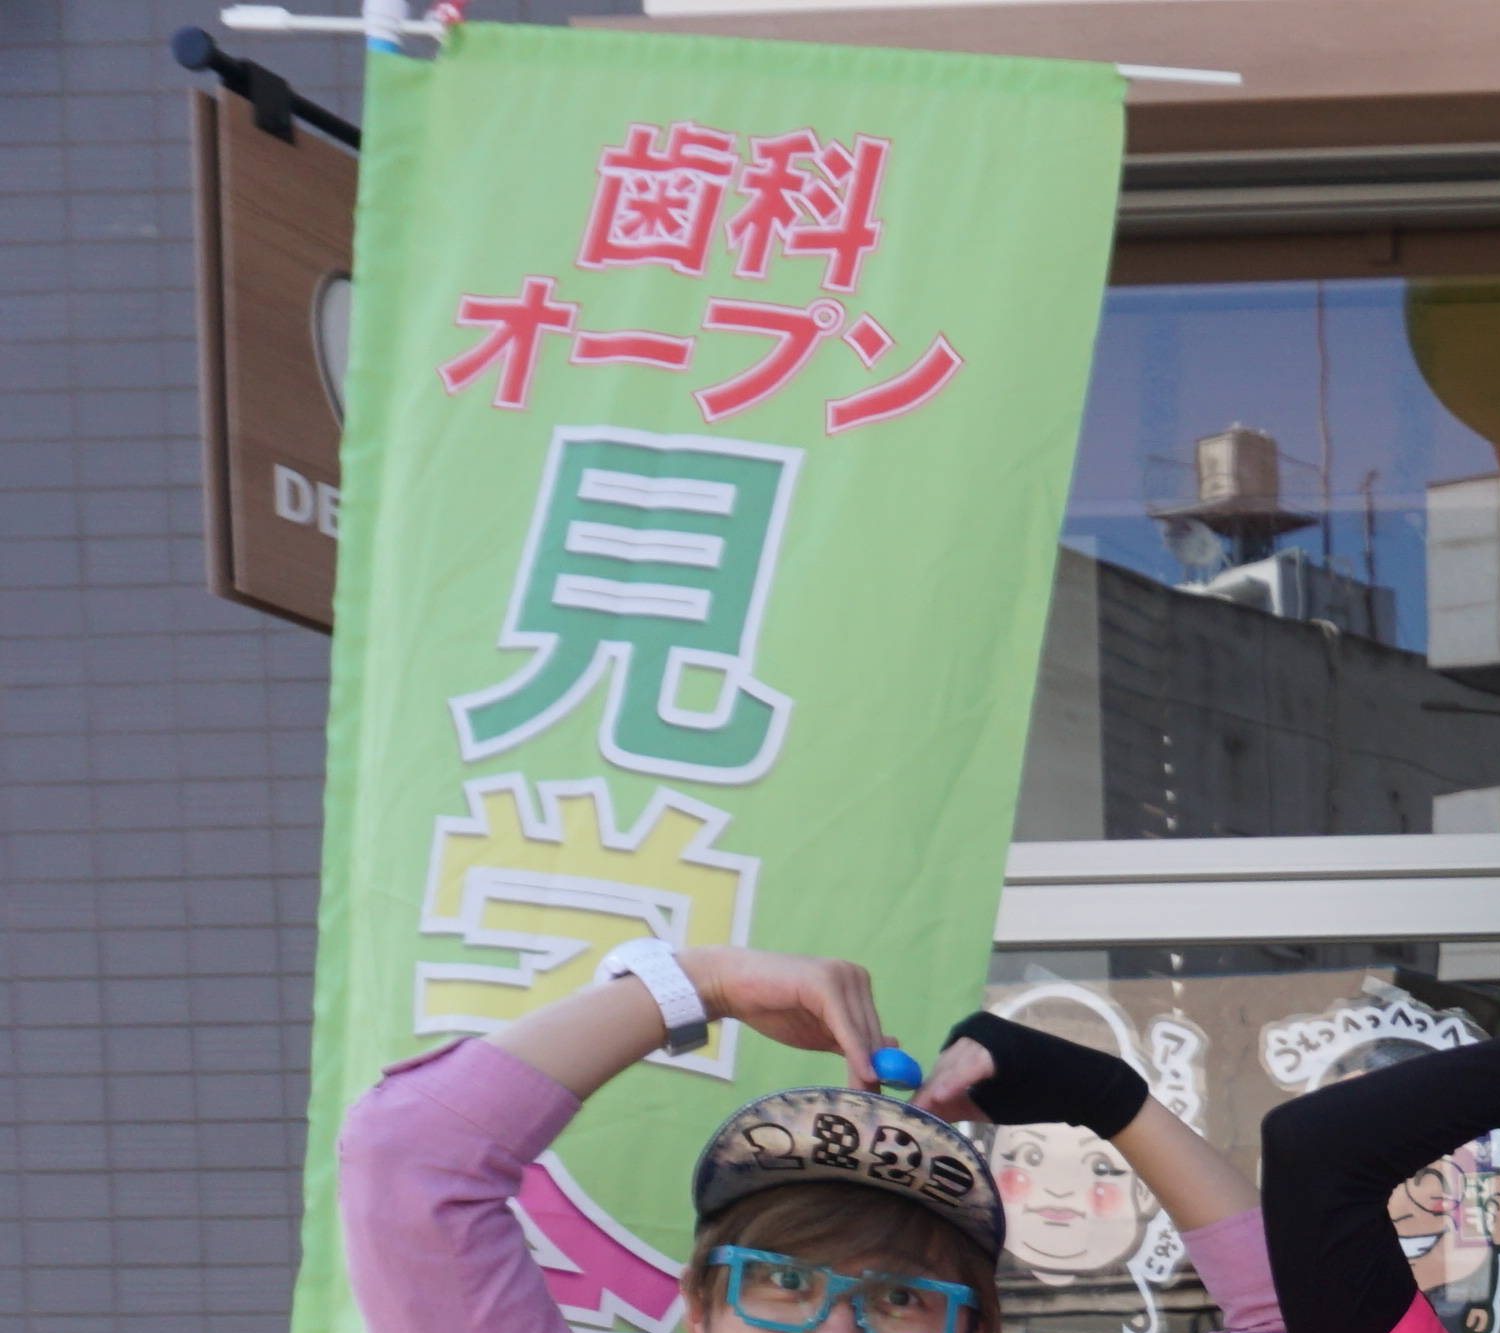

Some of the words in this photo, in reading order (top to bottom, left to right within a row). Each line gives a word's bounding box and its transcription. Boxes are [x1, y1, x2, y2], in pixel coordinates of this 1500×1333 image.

[574, 120, 891, 293] 歯科
[438, 275, 964, 436] オープン
